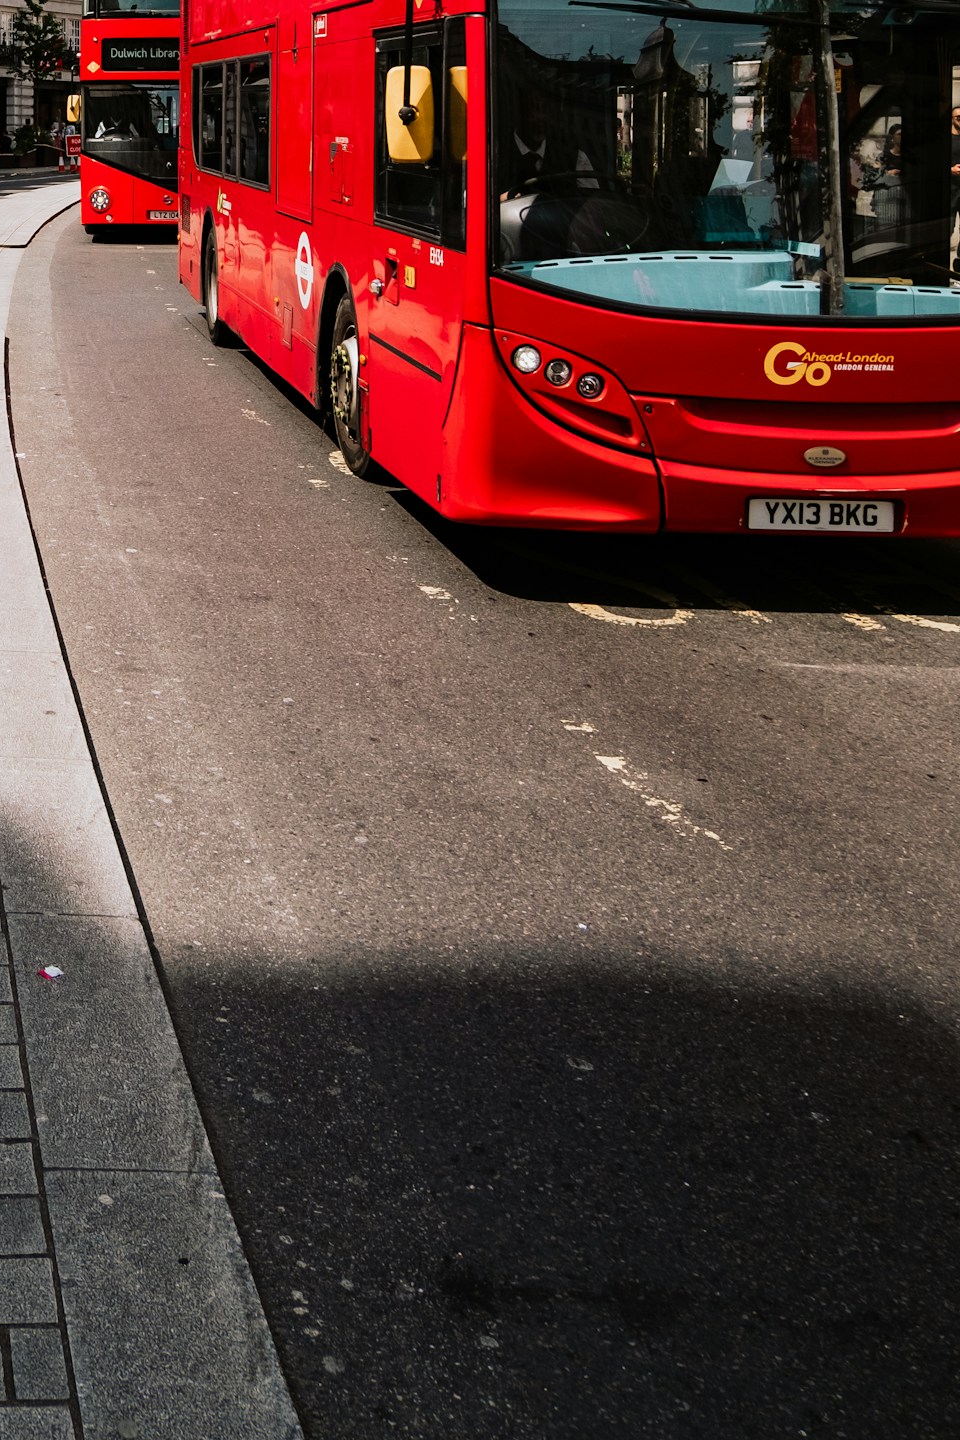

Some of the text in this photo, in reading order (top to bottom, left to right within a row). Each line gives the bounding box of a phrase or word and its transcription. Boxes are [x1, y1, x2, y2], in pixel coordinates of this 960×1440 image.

[110, 47, 180, 61] Dulwich Library
[429, 246, 444, 267] EH34
[763, 341, 832, 387] Go
[801, 351, 895, 364] Ahead-London
[833, 363, 895, 372] LONDON GENERAL
[765, 501, 878, 526] YX13 BKG
